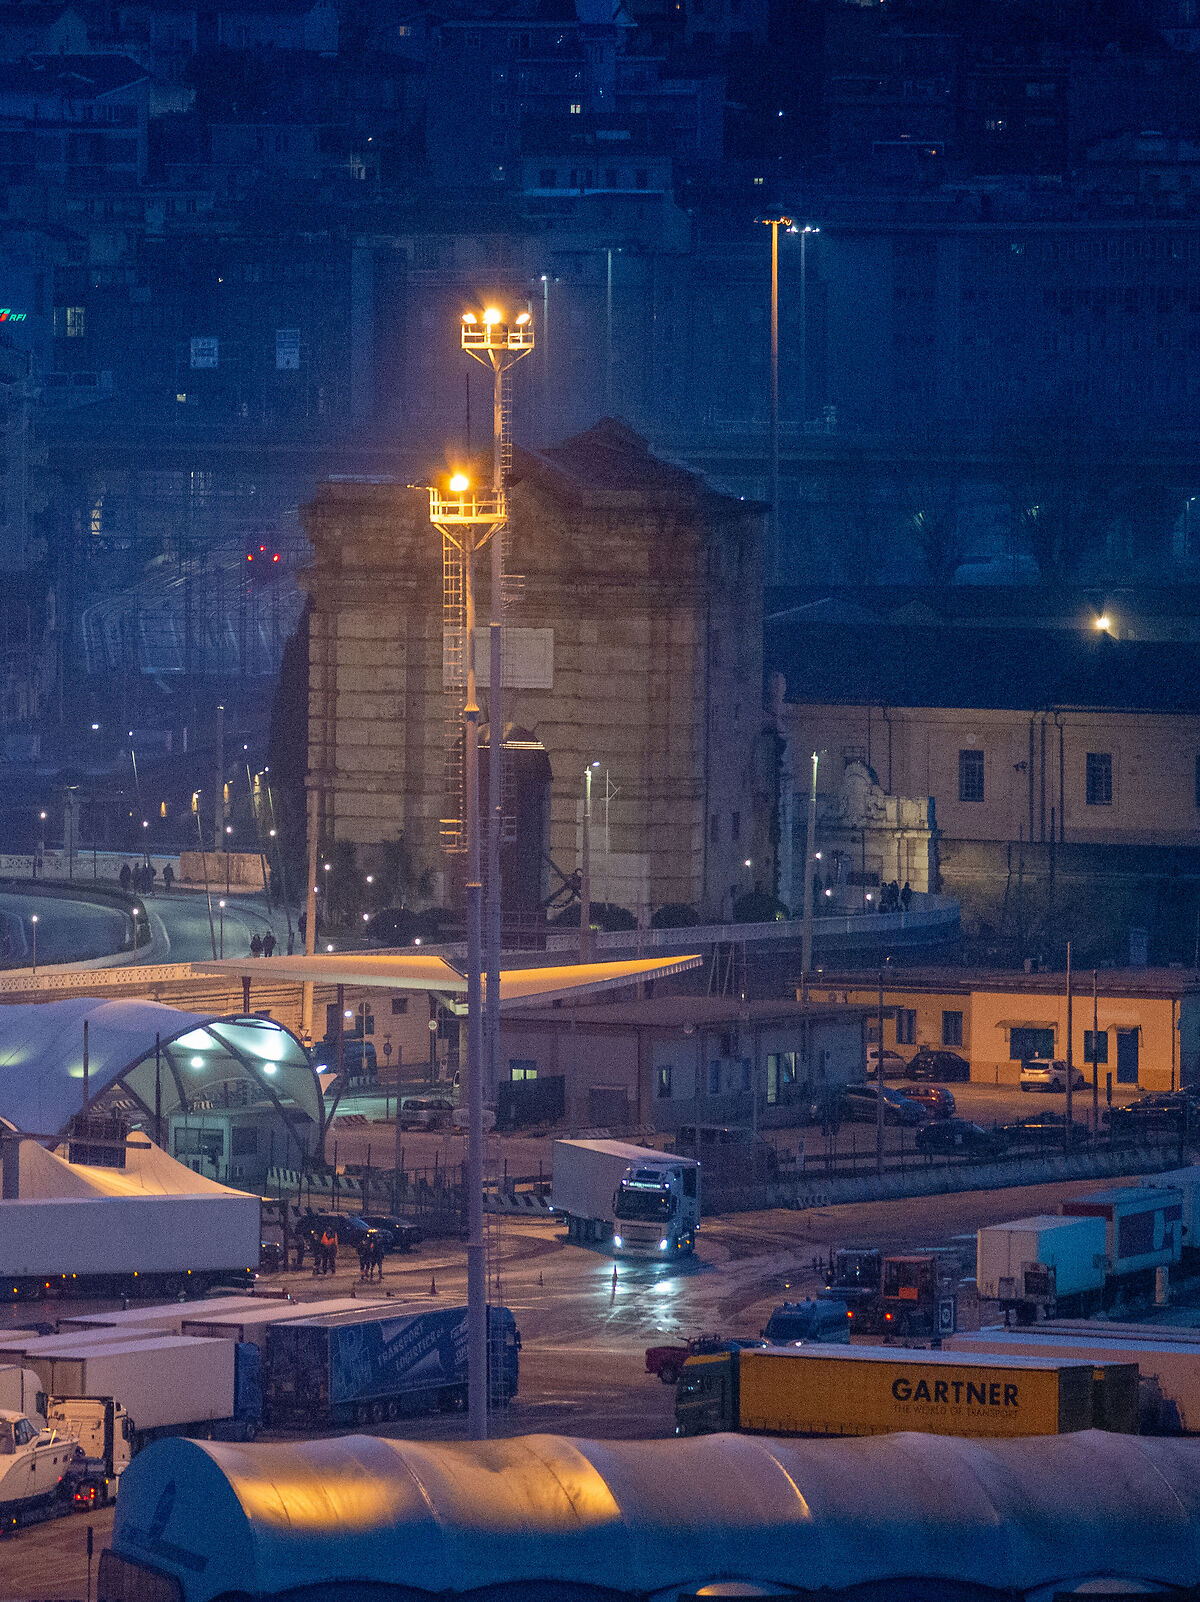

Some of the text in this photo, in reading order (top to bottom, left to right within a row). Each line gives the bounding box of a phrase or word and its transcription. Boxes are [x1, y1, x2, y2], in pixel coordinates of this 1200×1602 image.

[8, 313, 27, 322] RFI
[377, 1319, 425, 1367] TRANSPORT
[891, 1378, 1019, 1407] GARTNER
[893, 1405, 1018, 1419] THE WORLD OF TRANSPORT
